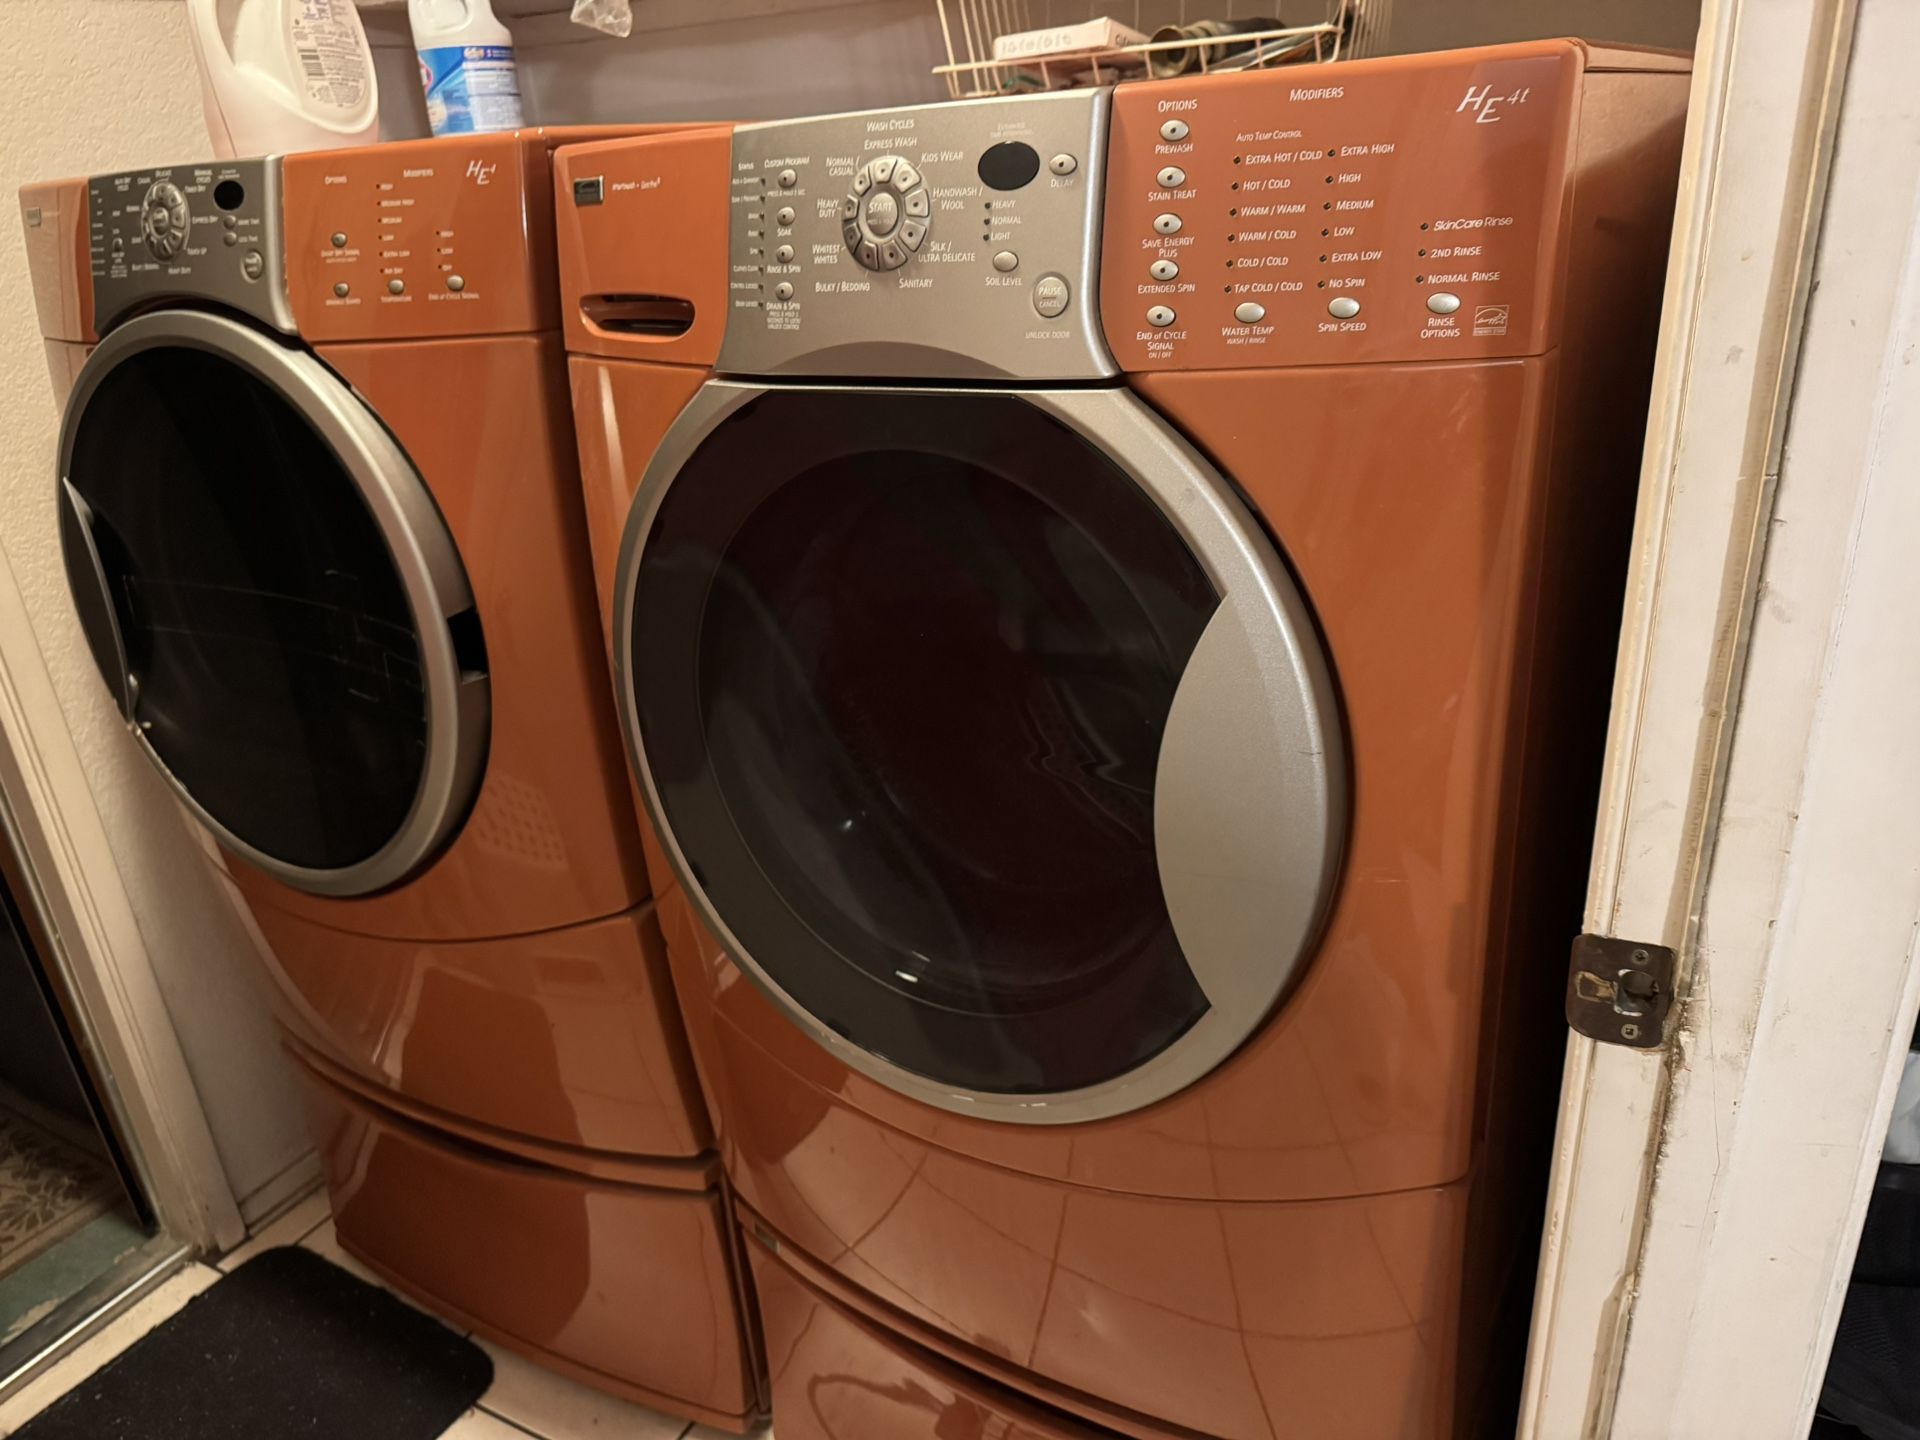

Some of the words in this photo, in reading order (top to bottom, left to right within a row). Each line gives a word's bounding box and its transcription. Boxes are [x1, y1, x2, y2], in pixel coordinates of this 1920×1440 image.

[1289, 87, 1344, 102] MODIFIERS
[1158, 99, 1197, 113] OPTIONS
[867, 120, 888, 132] WASH
[1236, 133, 1254, 142] AUTO
[864, 139, 893, 150] EXPRESS
[895, 137, 918, 148] WASH
[1155, 144, 1194, 155] PREWASH
[1341, 146, 1369, 157] EXTRA
[1370, 143, 1395, 154] HIGH
[826, 156, 854, 167] NORMAL
[921, 152, 938, 163] KIDS
[940, 151, 963, 161] WEAR
[1245, 155, 1272, 165] EXTRA
[1273, 152, 1292, 163] HOT
[1299, 151, 1323, 161] COLD
[829, 167, 854, 176] CASUAL
[1338, 173, 1362, 184] HIGH
[1243, 180, 1261, 191] HOT
[1268, 179, 1291, 189] COLD
[933, 187, 978, 198] HANDWASH
[1148, 191, 1171, 202] STAIN
[1173, 189, 1198, 200] TREAT
[817, 199, 839, 208] HEAVY
[868, 202, 892, 213] START
[941, 200, 964, 210] WOOL
[992, 200, 1016, 208] HEAVY
[1335, 199, 1375, 211] MEDIUM
[819, 209, 836, 218] DUTY
[1240, 206, 1269, 216] WARM
[1276, 204, 1306, 214] WARM
[991, 217, 1021, 225] NORMAL
[1433, 218, 1483, 232] SkinCare
[1484, 216, 1513, 228] Rinse
[777, 228, 792, 237] SOAK
[990, 232, 1011, 241] LIGHT
[1238, 231, 1267, 242] WARM
[1274, 229, 1297, 240] COLD
[1333, 226, 1355, 237] LOW
[930, 241, 946, 252] SILK
[1142, 239, 1162, 249] SAVE
[1164, 236, 1195, 247] ENERGY
[812, 244, 840, 254] WHITEST
[1158, 248, 1178, 258] PLUS
[1430, 248, 1452, 259] 2ND
[1453, 246, 1482, 257] RINSE
[814, 255, 838, 264] WHITES
[918, 253, 940, 263] ULTRA
[942, 252, 976, 262] DELICATE
[1237, 257, 1259, 268] COLD
[1266, 256, 1289, 266] COLD
[1331, 252, 1359, 263] EXTRA
[1360, 250, 1383, 261] LOW
[985, 277, 1000, 286] SOIL
[1002, 277, 1023, 286] LEVEL
[1328, 279, 1343, 288] NO
[1344, 277, 1366, 288] SPIN
[1427, 273, 1469, 284] NORMAL
[1470, 271, 1501, 282] RINSE
[815, 281, 836, 292] BULKY
[841, 281, 870, 292] BEDDING
[899, 279, 933, 288] SANITARY
[1137, 284, 1176, 294] EXTENDED
[1177, 283, 1196, 293] SPIN
[1234, 284, 1250, 294] TAP
[1251, 282, 1273, 292] COLD
[1280, 281, 1303, 291] COLD
[1038, 287, 1062, 296] PAUSE
[1318, 322, 1338, 333] SPIN
[1339, 321, 1366, 332] SPEED
[1427, 317, 1455, 327] RINSE
[1136, 331, 1153, 340] END
[1163, 331, 1187, 340] CYCLE
[1221, 326, 1250, 337] WATER
[1251, 325, 1275, 335] TEMP
[1420, 328, 1461, 339] OPTIONS
[1147, 341, 1174, 351] SIGNAL
